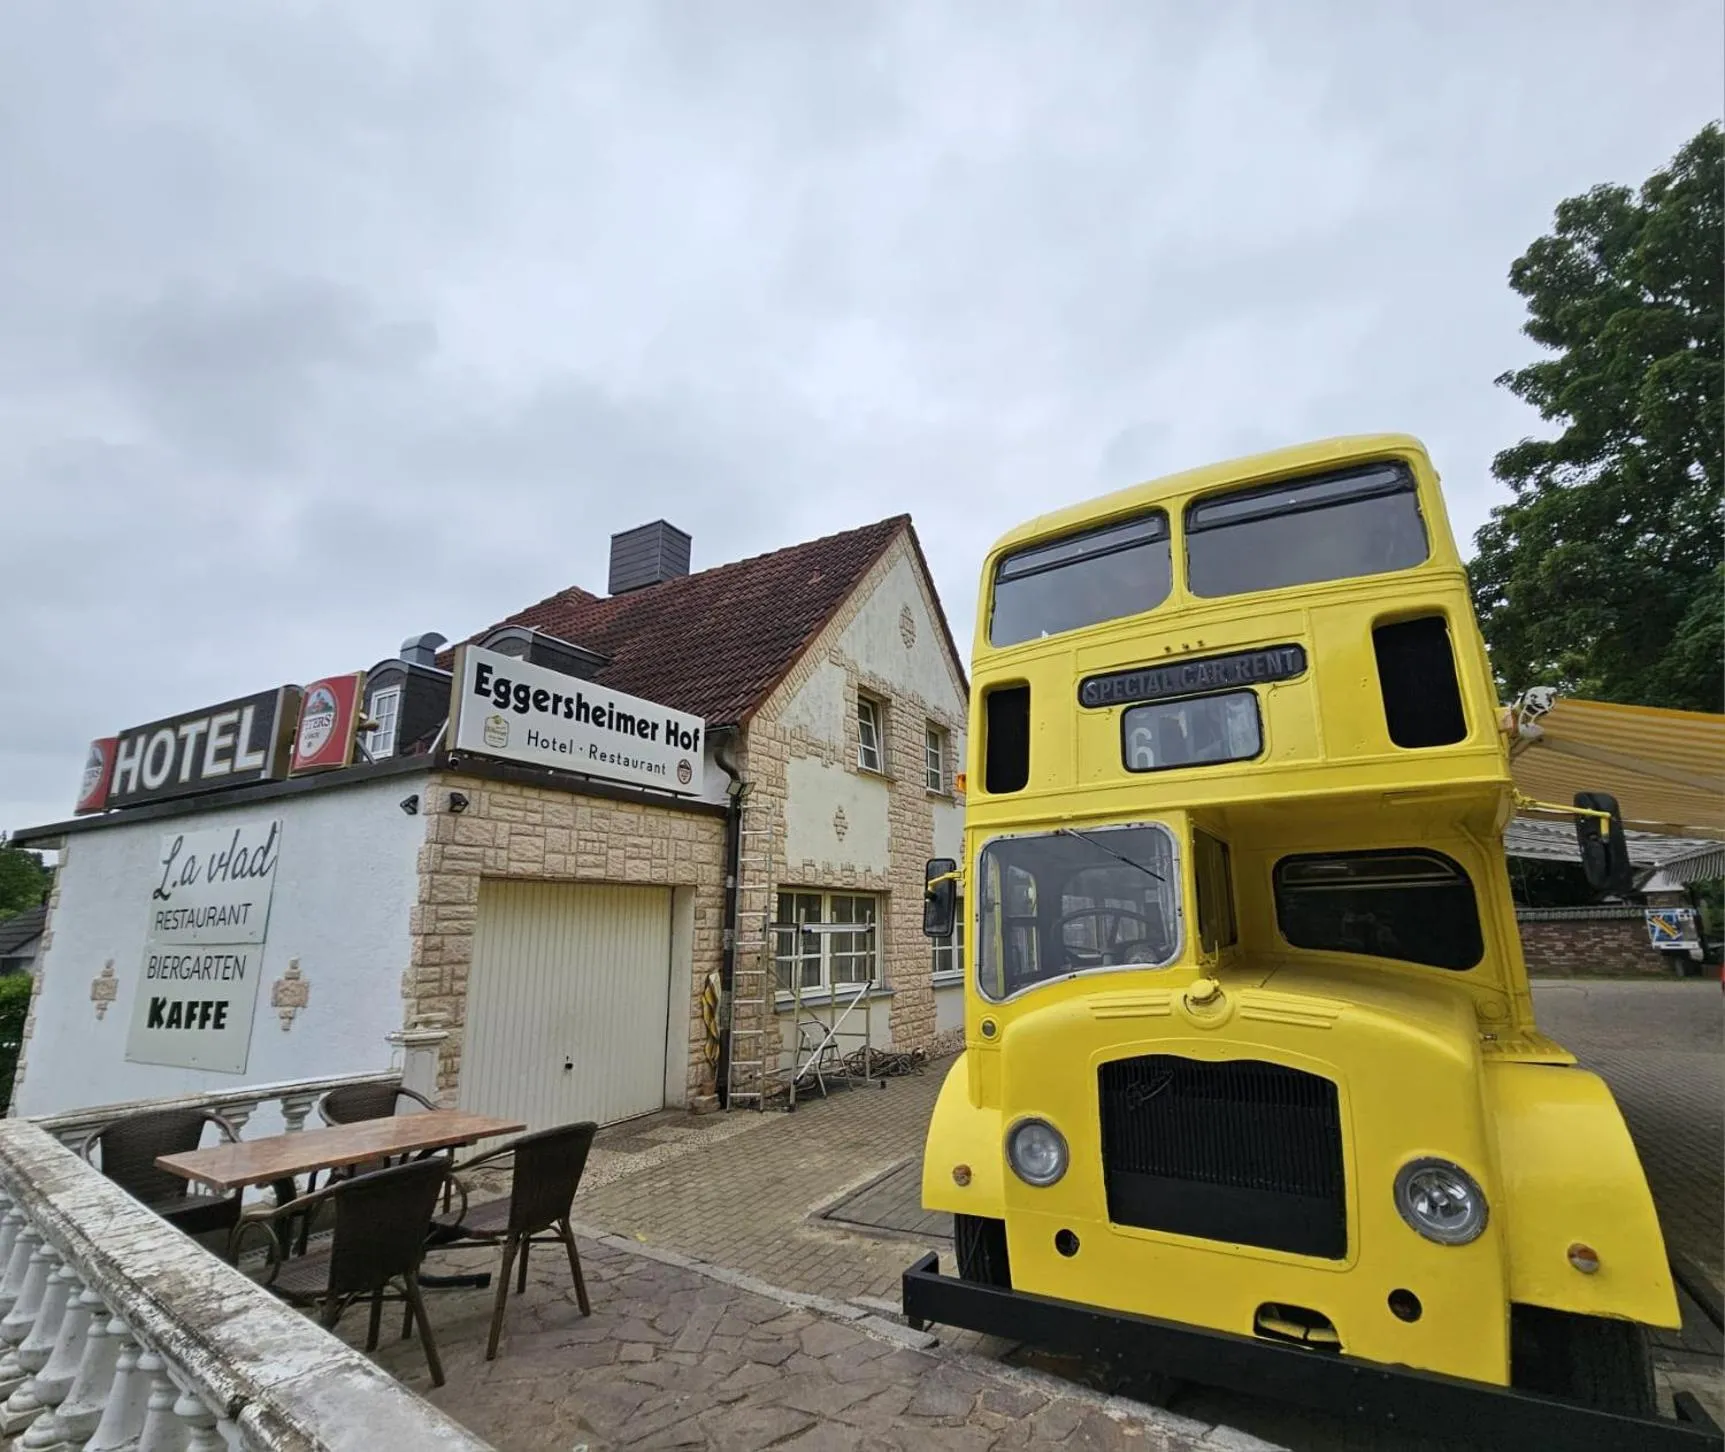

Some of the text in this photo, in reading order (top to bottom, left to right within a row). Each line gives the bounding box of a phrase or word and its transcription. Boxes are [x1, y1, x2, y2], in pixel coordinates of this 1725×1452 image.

[1083, 649, 1296, 702] SPECIAL CAR RENT
[474, 662, 700, 752] Eggersheimer Hof
[110, 705, 267, 796] HOTEL
[527, 729, 573, 755] Hotel
[589, 744, 666, 776] Restaurant
[155, 903, 252, 931] RESTAURANT
[146, 954, 247, 981] BIERGARTEN
[147, 996, 229, 1031] KAFFE
